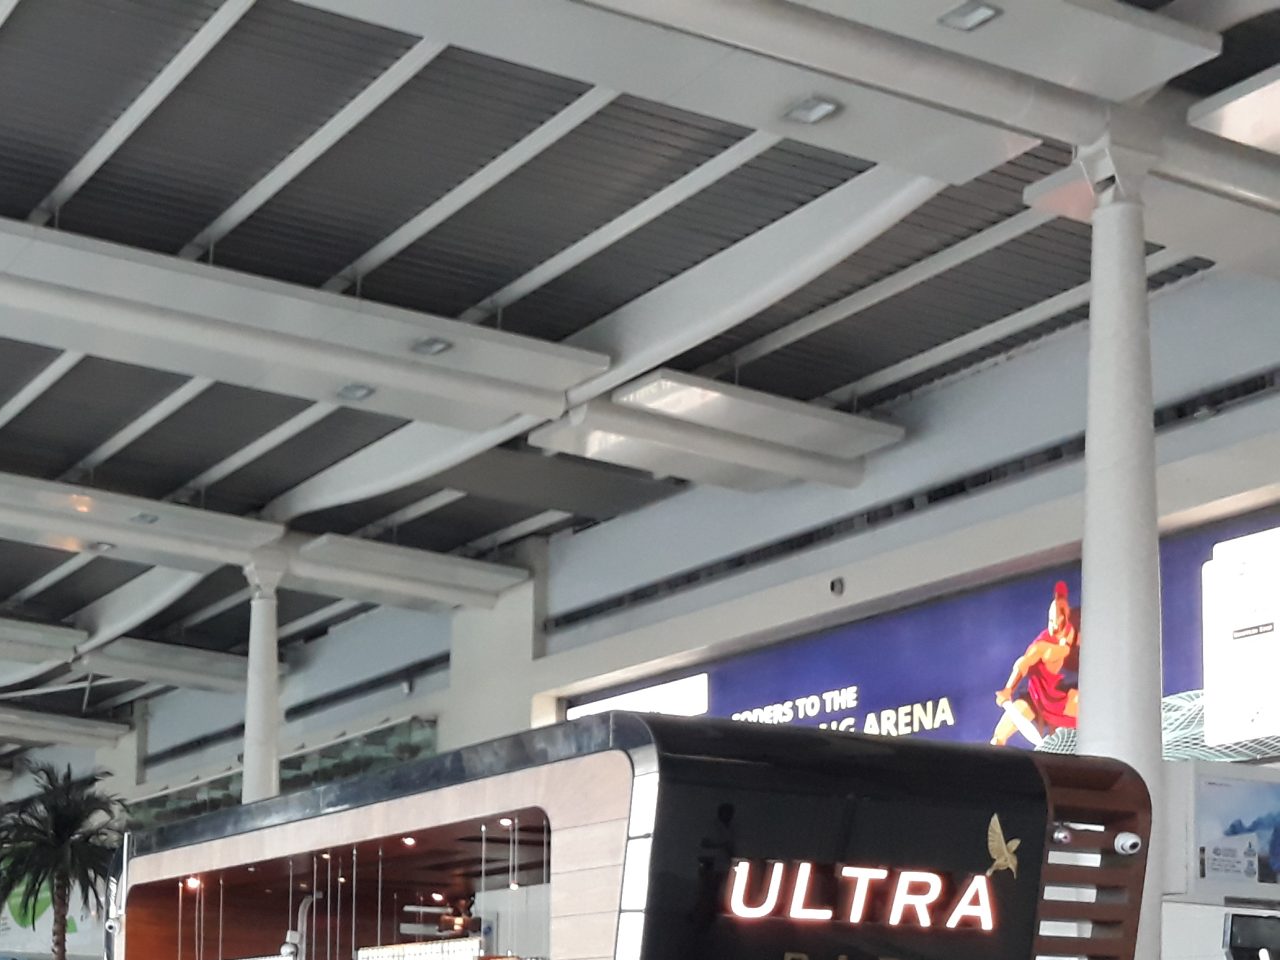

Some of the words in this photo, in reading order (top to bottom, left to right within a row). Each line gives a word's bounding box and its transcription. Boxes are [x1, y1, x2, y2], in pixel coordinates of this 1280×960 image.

[795, 695, 821, 719] TO
[822, 685, 858, 714] THE
[863, 697, 955, 737] ARENA
[729, 861, 994, 932] ULTRA
